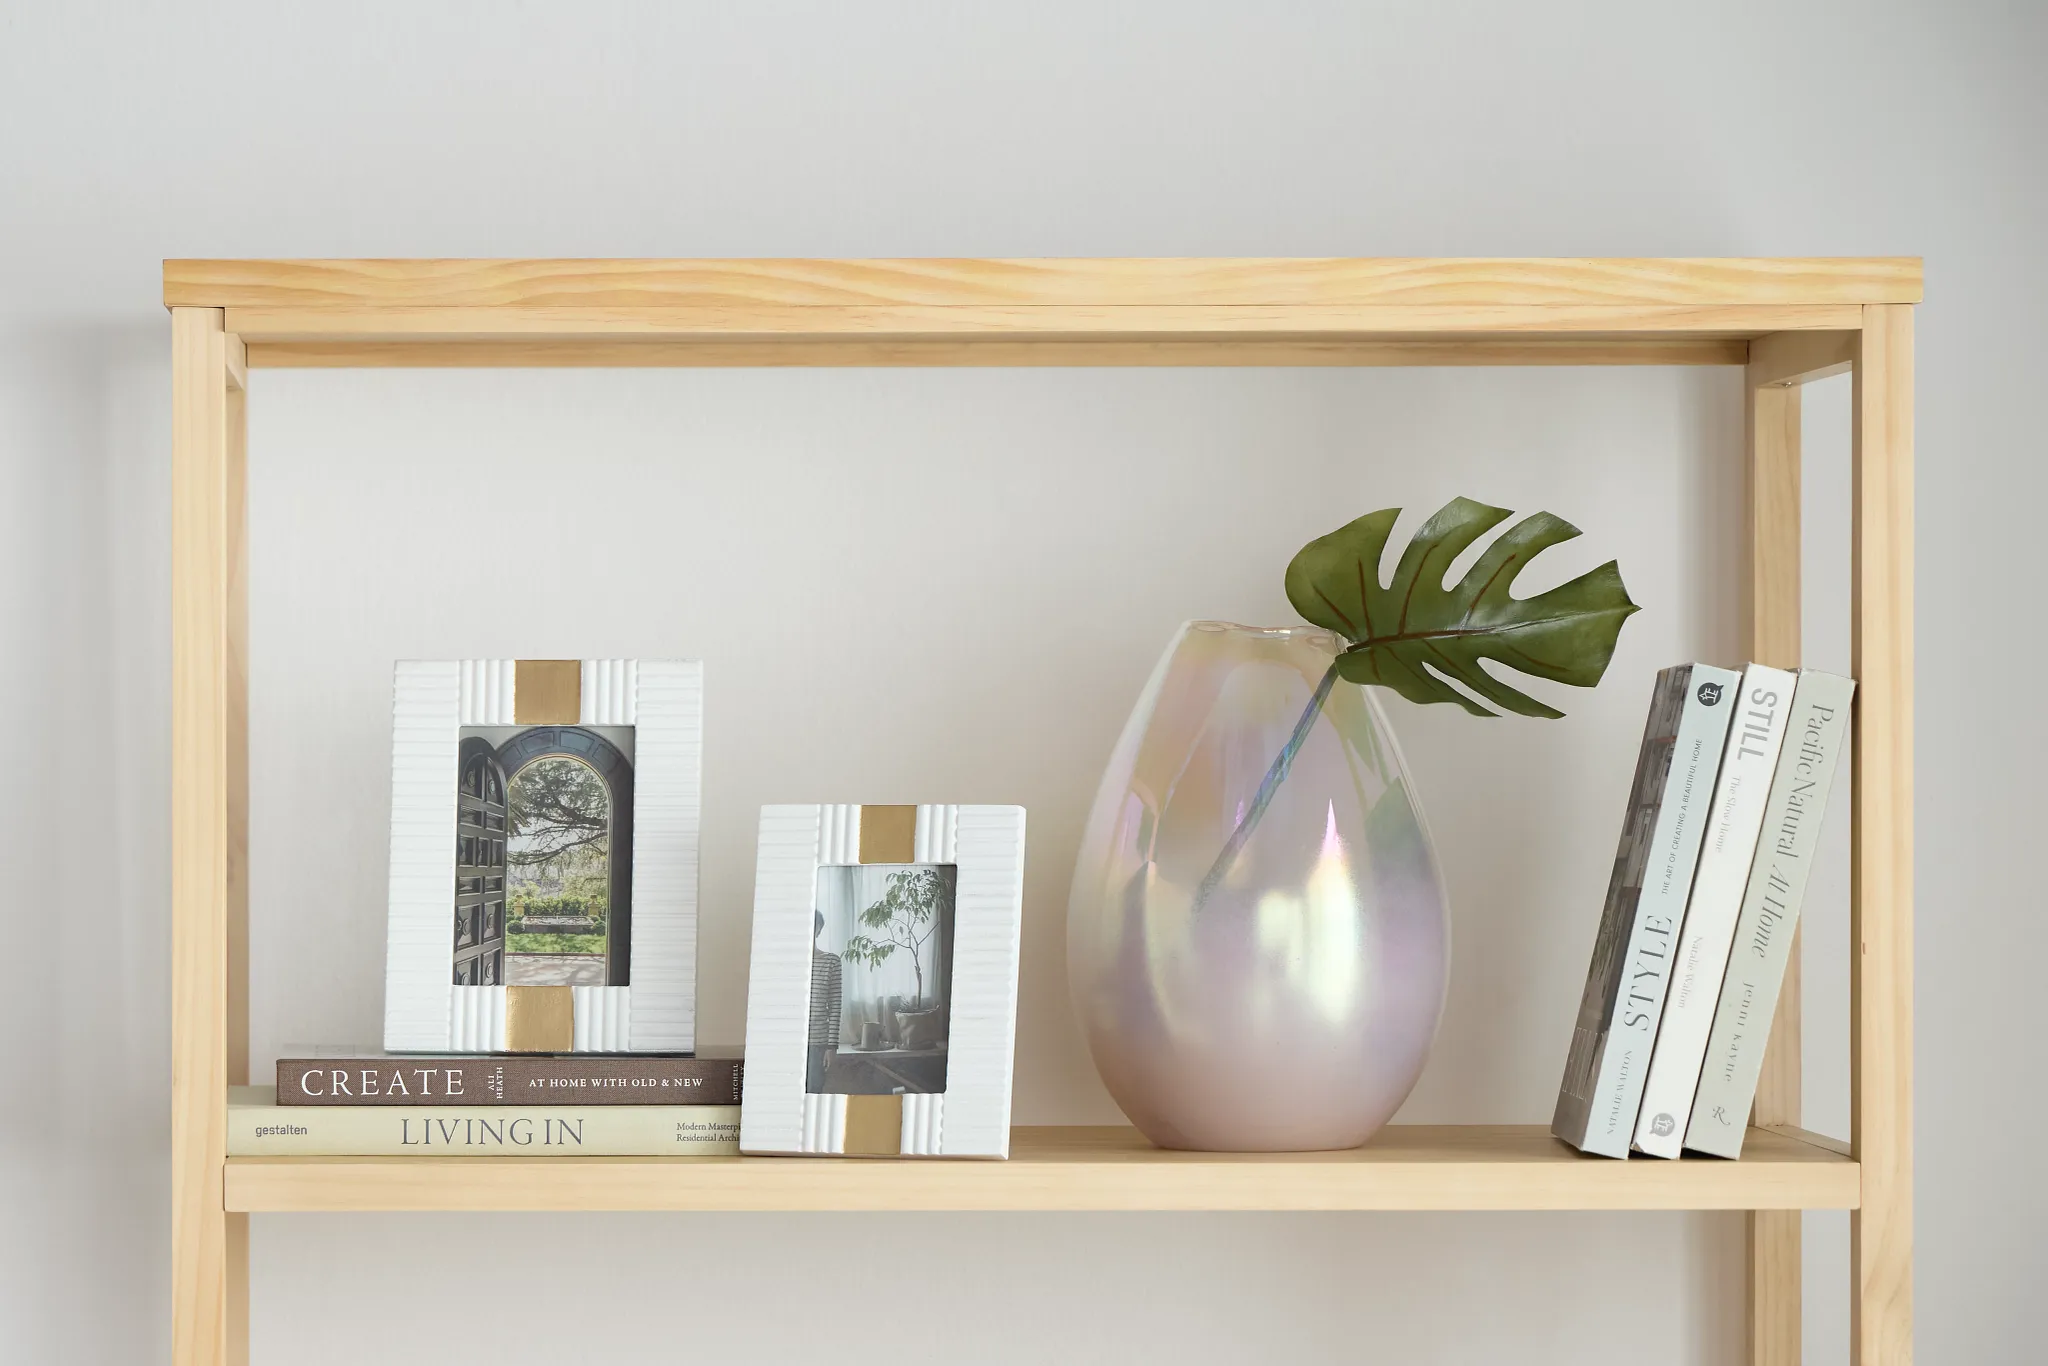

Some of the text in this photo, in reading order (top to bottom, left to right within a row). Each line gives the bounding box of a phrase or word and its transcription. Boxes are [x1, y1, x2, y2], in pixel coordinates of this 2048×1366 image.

[1737, 687, 1778, 760] STILL
[1691, 738, 1703, 762] HOME
[1682, 764, 1697, 803] BEAUTIFUL
[1715, 774, 1741, 853] The Slow Home
[1671, 812, 1686, 850] CREATING
[1751, 703, 1834, 958] Pacific Natural At Home
[1668, 851, 1677, 863] OF
[1665, 865, 1674, 879] ART
[1661, 880, 1670, 895] THE
[1623, 915, 1672, 1031] STYLE
[1678, 936, 1704, 1009] Natalie Walton
[301, 1069, 465, 1096] CREATE
[487, 1075, 495, 1091] ALI
[529, 1078, 703, 1088] AT HOME WITH OLD & NEW
[1606, 1050, 1633, 1135] NATALIE WALTON
[255, 1124, 308, 1138] gestalten
[400, 1117, 585, 1146] LIVING IN
[676, 1122, 707, 1131] Modern
[676, 1133, 717, 1142] Residential
